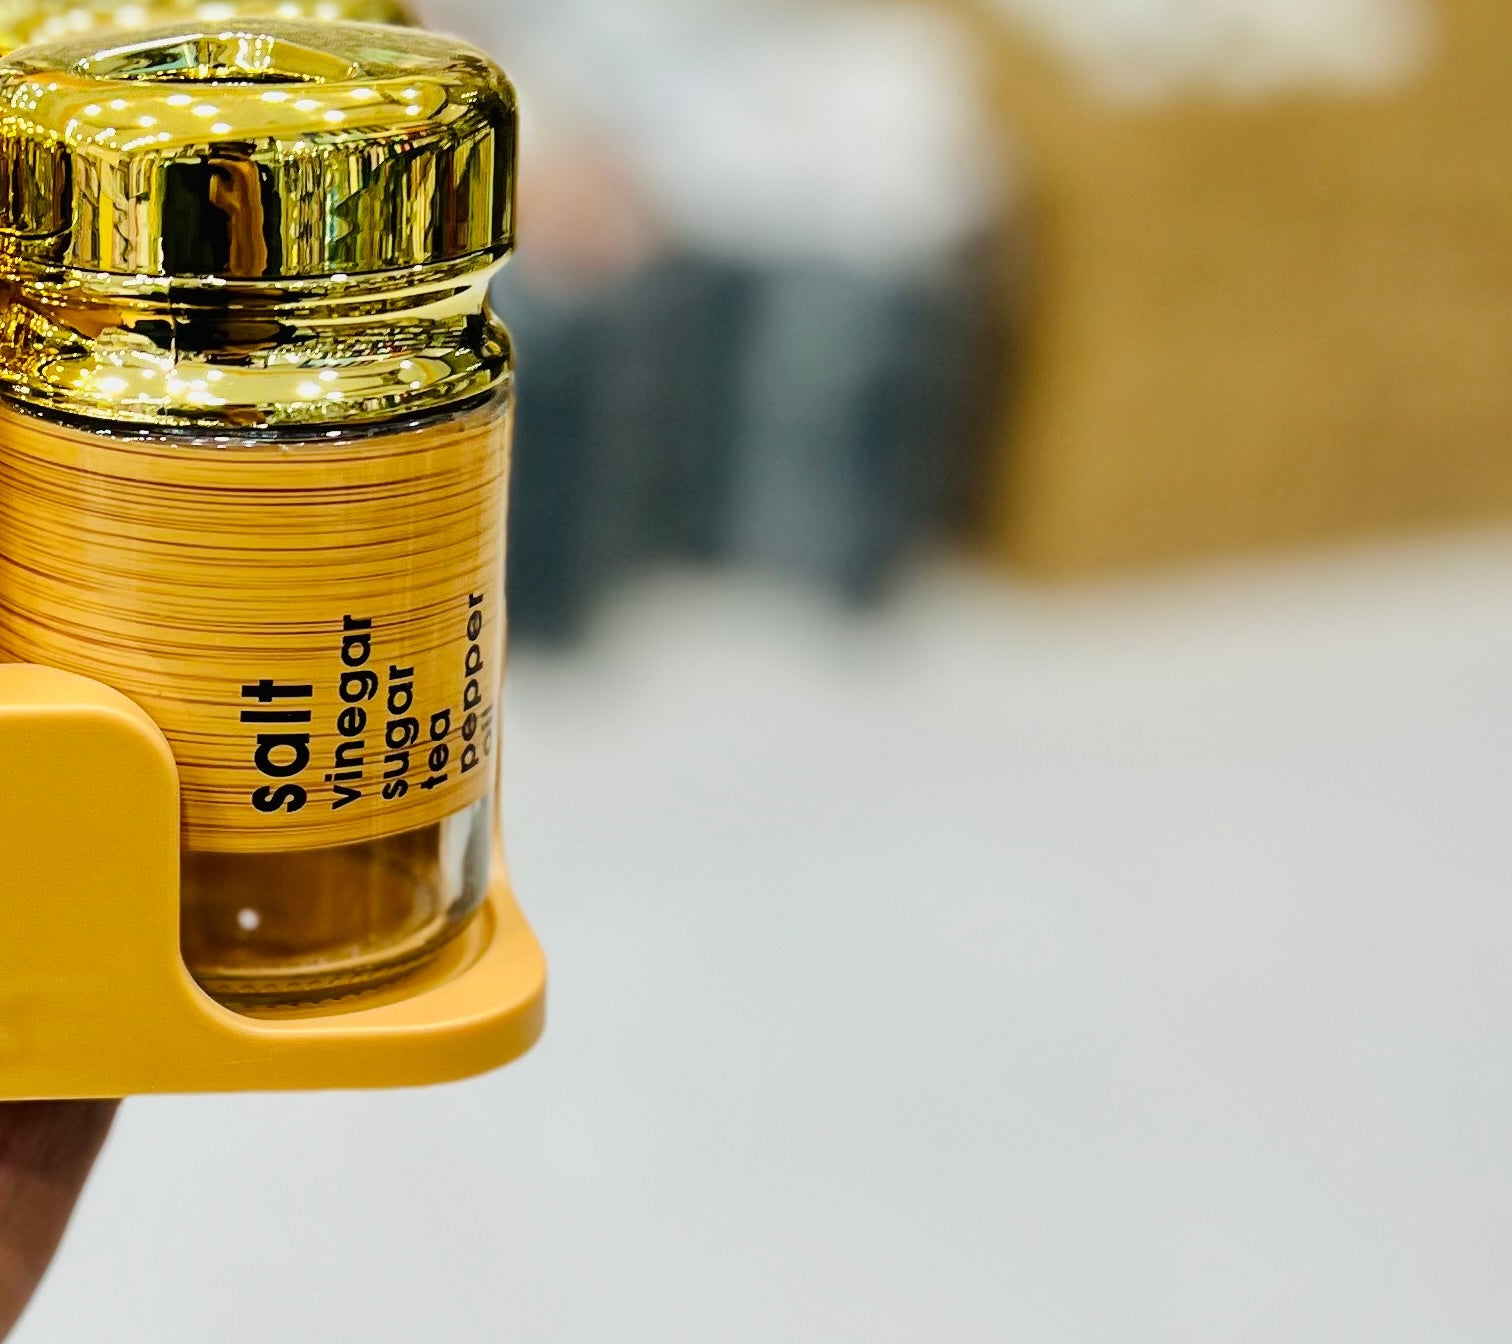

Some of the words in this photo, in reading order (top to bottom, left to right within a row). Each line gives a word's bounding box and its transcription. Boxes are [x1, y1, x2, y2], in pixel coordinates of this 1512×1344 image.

[240, 679, 313, 813] salt
[325, 615, 378, 810] vinegar
[382, 664, 419, 800] sugar
[421, 709, 451, 790] tea
[460, 593, 484, 773] pepper
